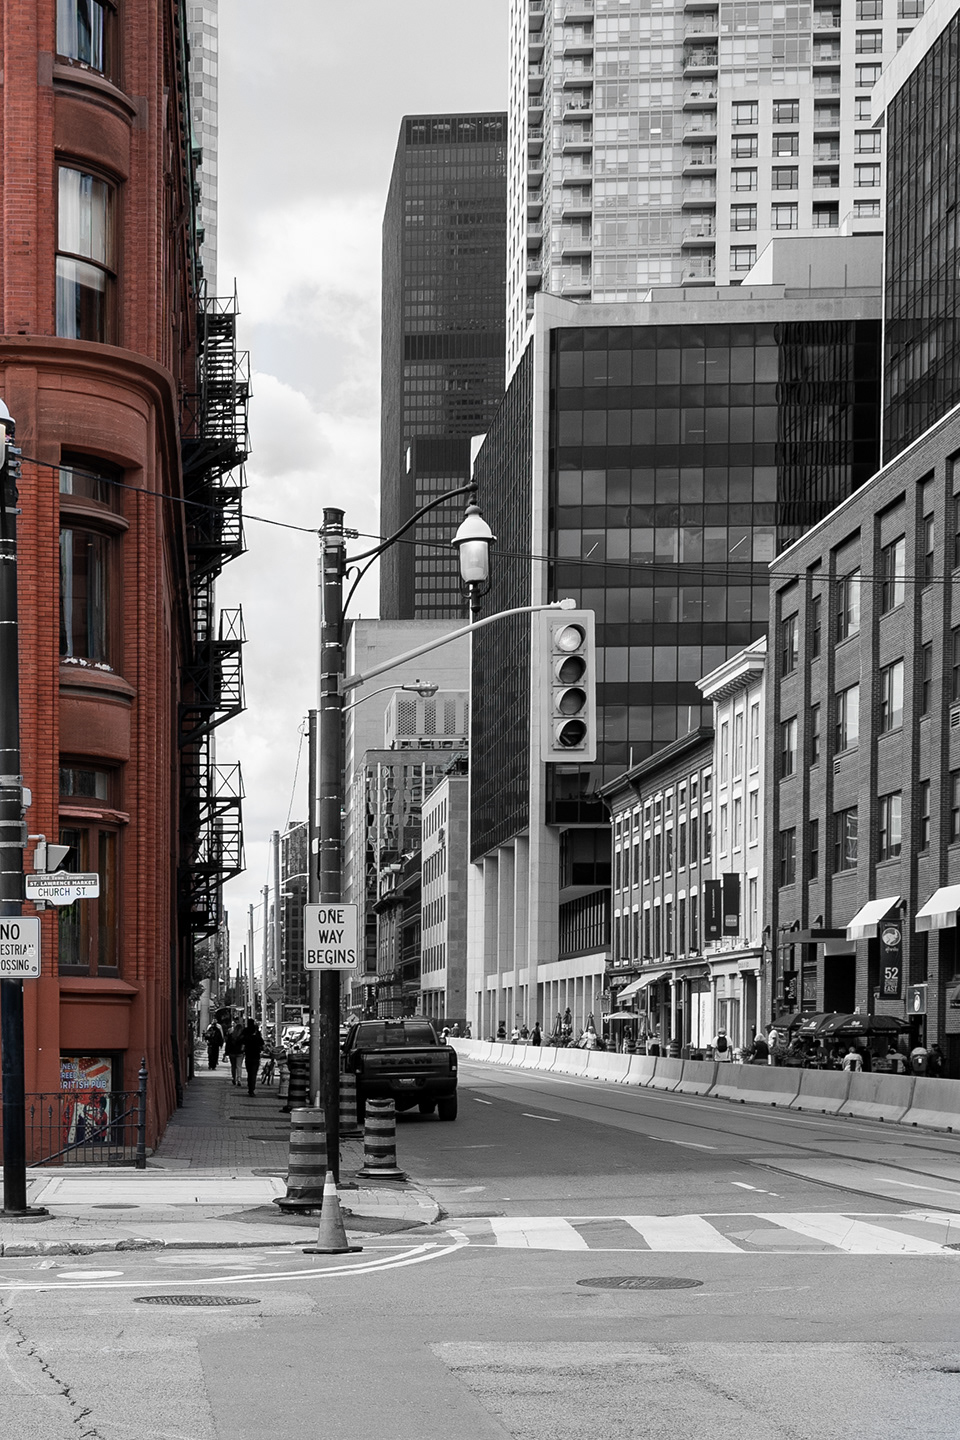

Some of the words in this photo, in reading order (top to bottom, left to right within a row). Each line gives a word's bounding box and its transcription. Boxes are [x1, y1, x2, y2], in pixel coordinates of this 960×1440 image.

[38, 887, 71, 897] CHURCH
[76, 887, 87, 896] ST.
[318, 909, 344, 924] ONE
[0, 924, 20, 940] NO
[319, 930, 344, 944] WAY
[308, 949, 355, 964] BEGINS
[884, 967, 898, 979] 52
[381, 1057, 432, 1065] RAM
[60, 1081, 89, 1089] RITISH
[91, 1080, 107, 1089] PUB
